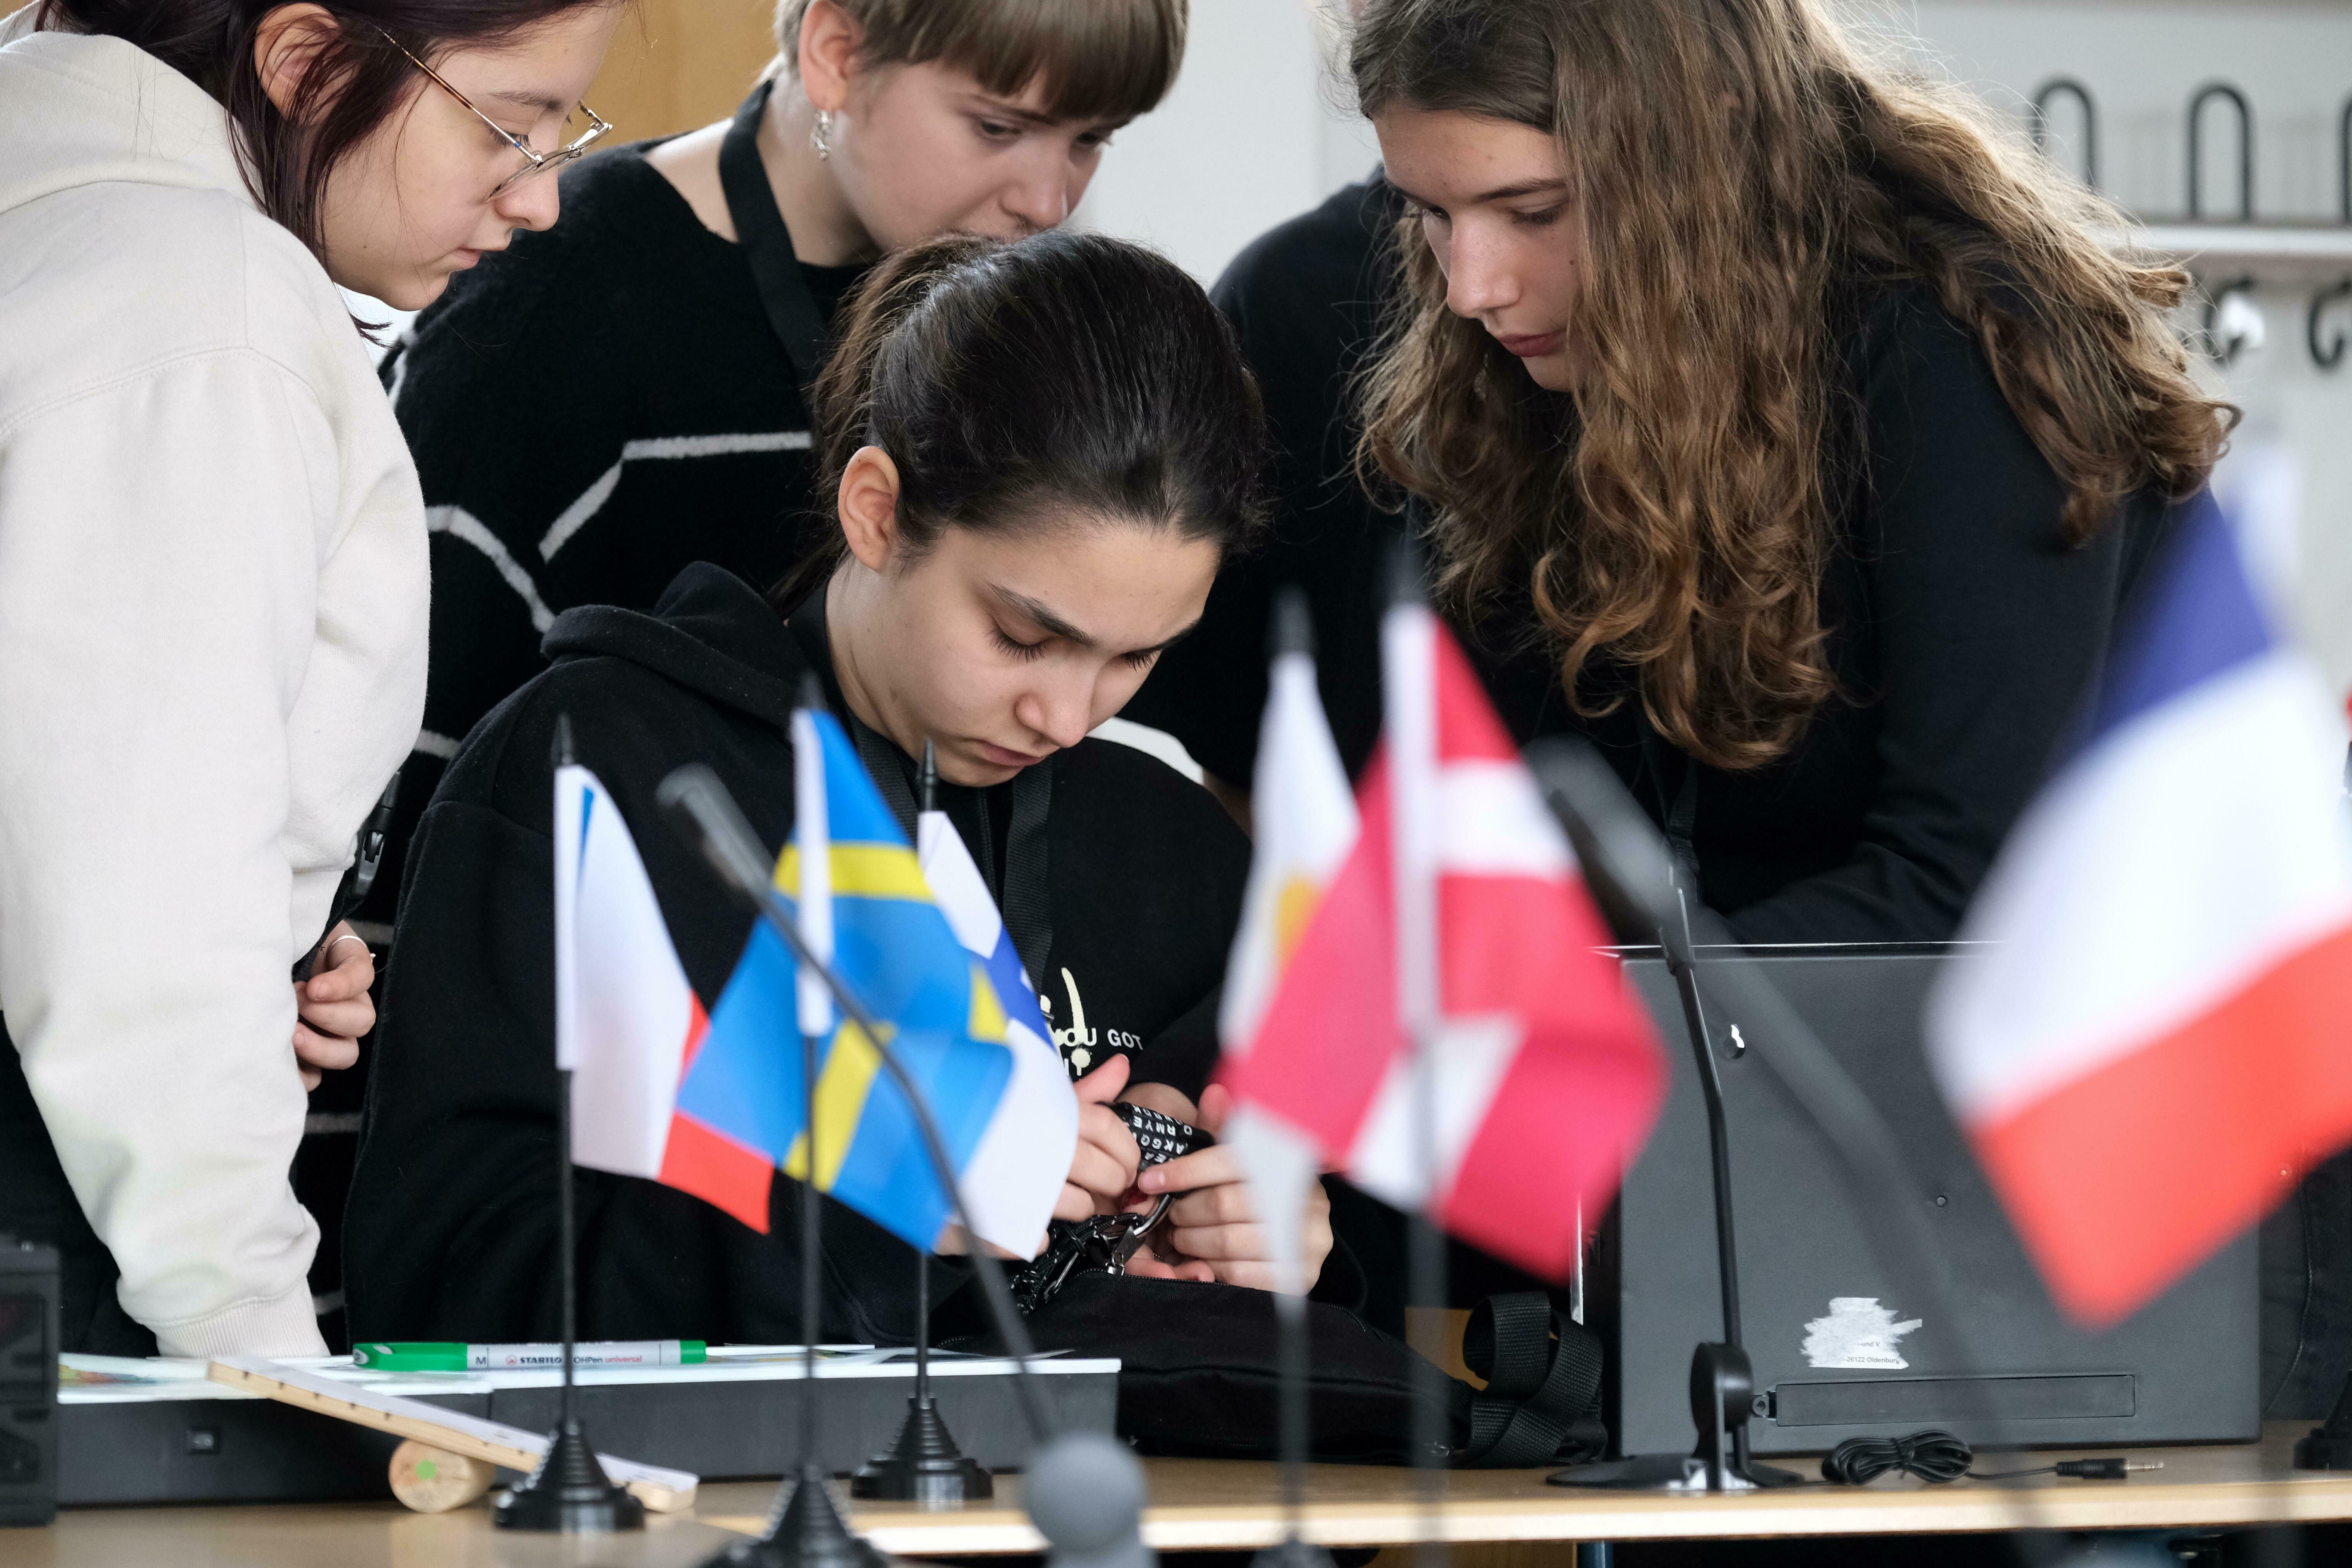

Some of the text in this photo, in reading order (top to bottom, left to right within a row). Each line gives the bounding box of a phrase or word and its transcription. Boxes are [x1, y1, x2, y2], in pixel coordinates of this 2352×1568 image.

[1107, 1028, 1143, 1050] GOT
[476, 1357, 486, 1365] M
[605, 1355, 642, 1363] universal
